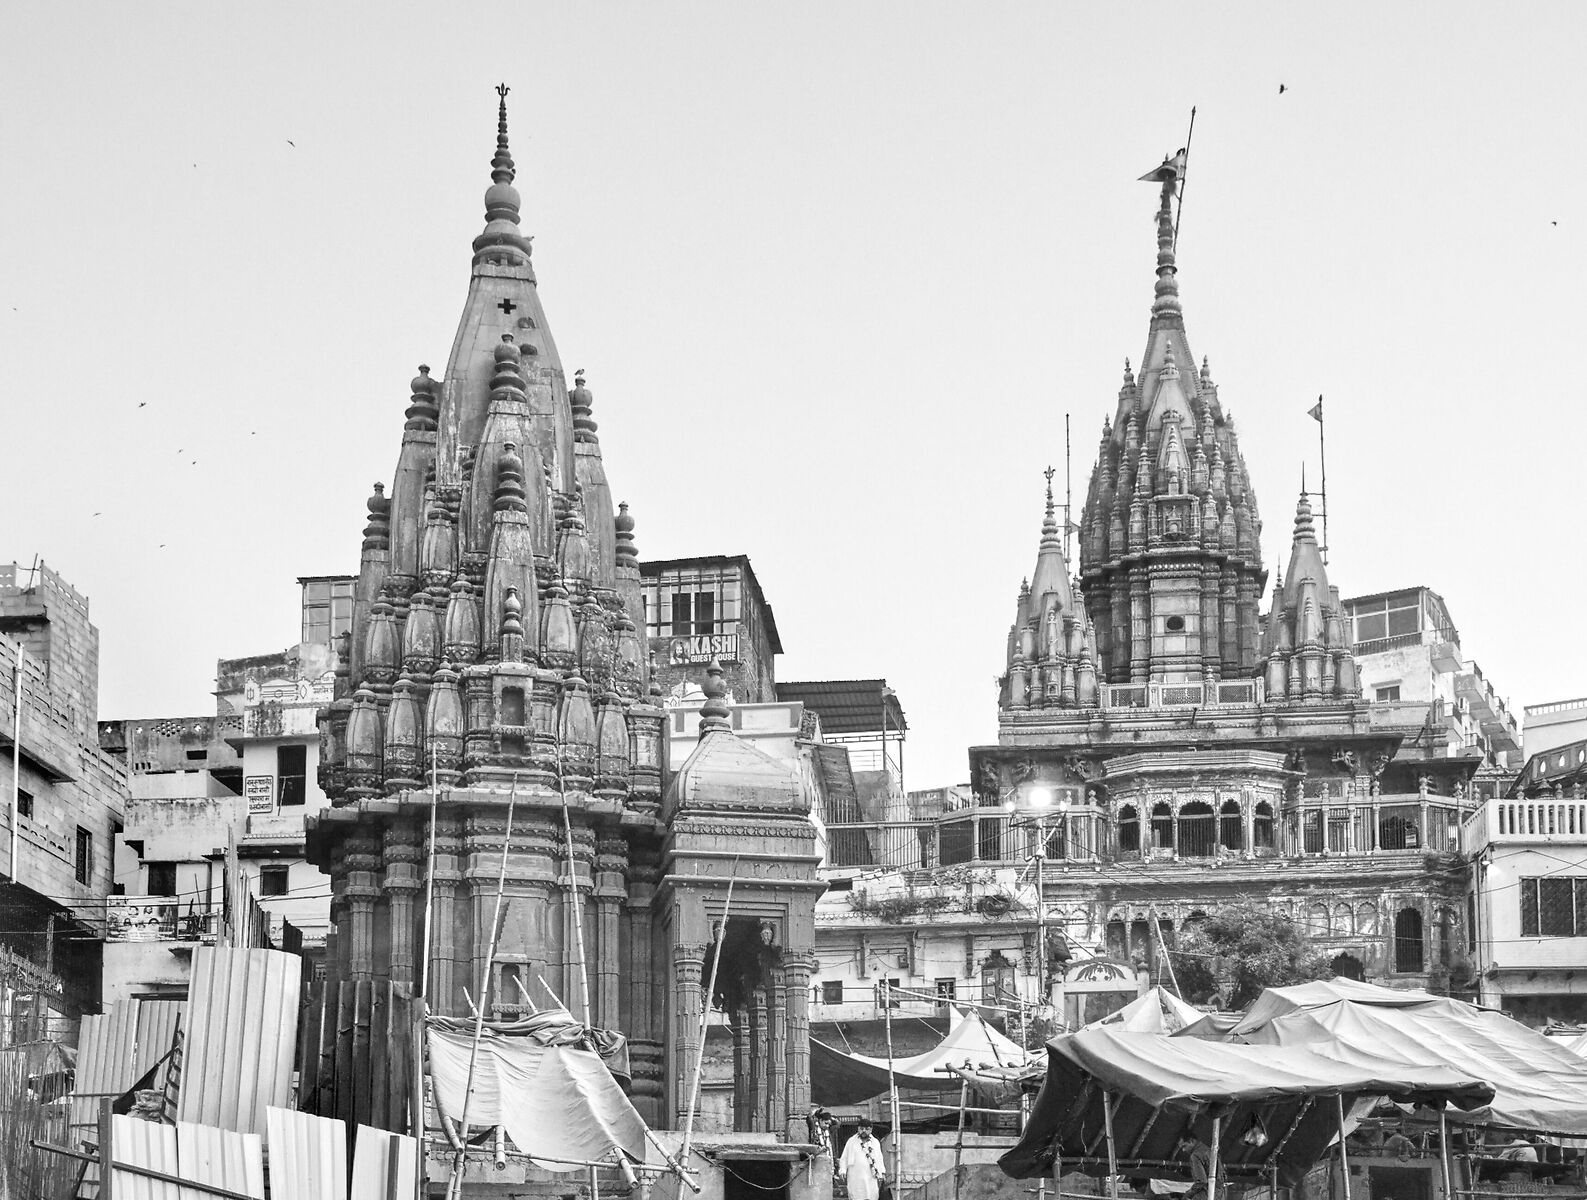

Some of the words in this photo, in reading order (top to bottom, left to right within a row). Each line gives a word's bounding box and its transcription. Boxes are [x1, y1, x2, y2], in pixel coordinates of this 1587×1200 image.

[690, 635, 736, 654] KASHI
[690, 654, 712, 663] GUEST
[715, 652, 736, 661] OUSE
